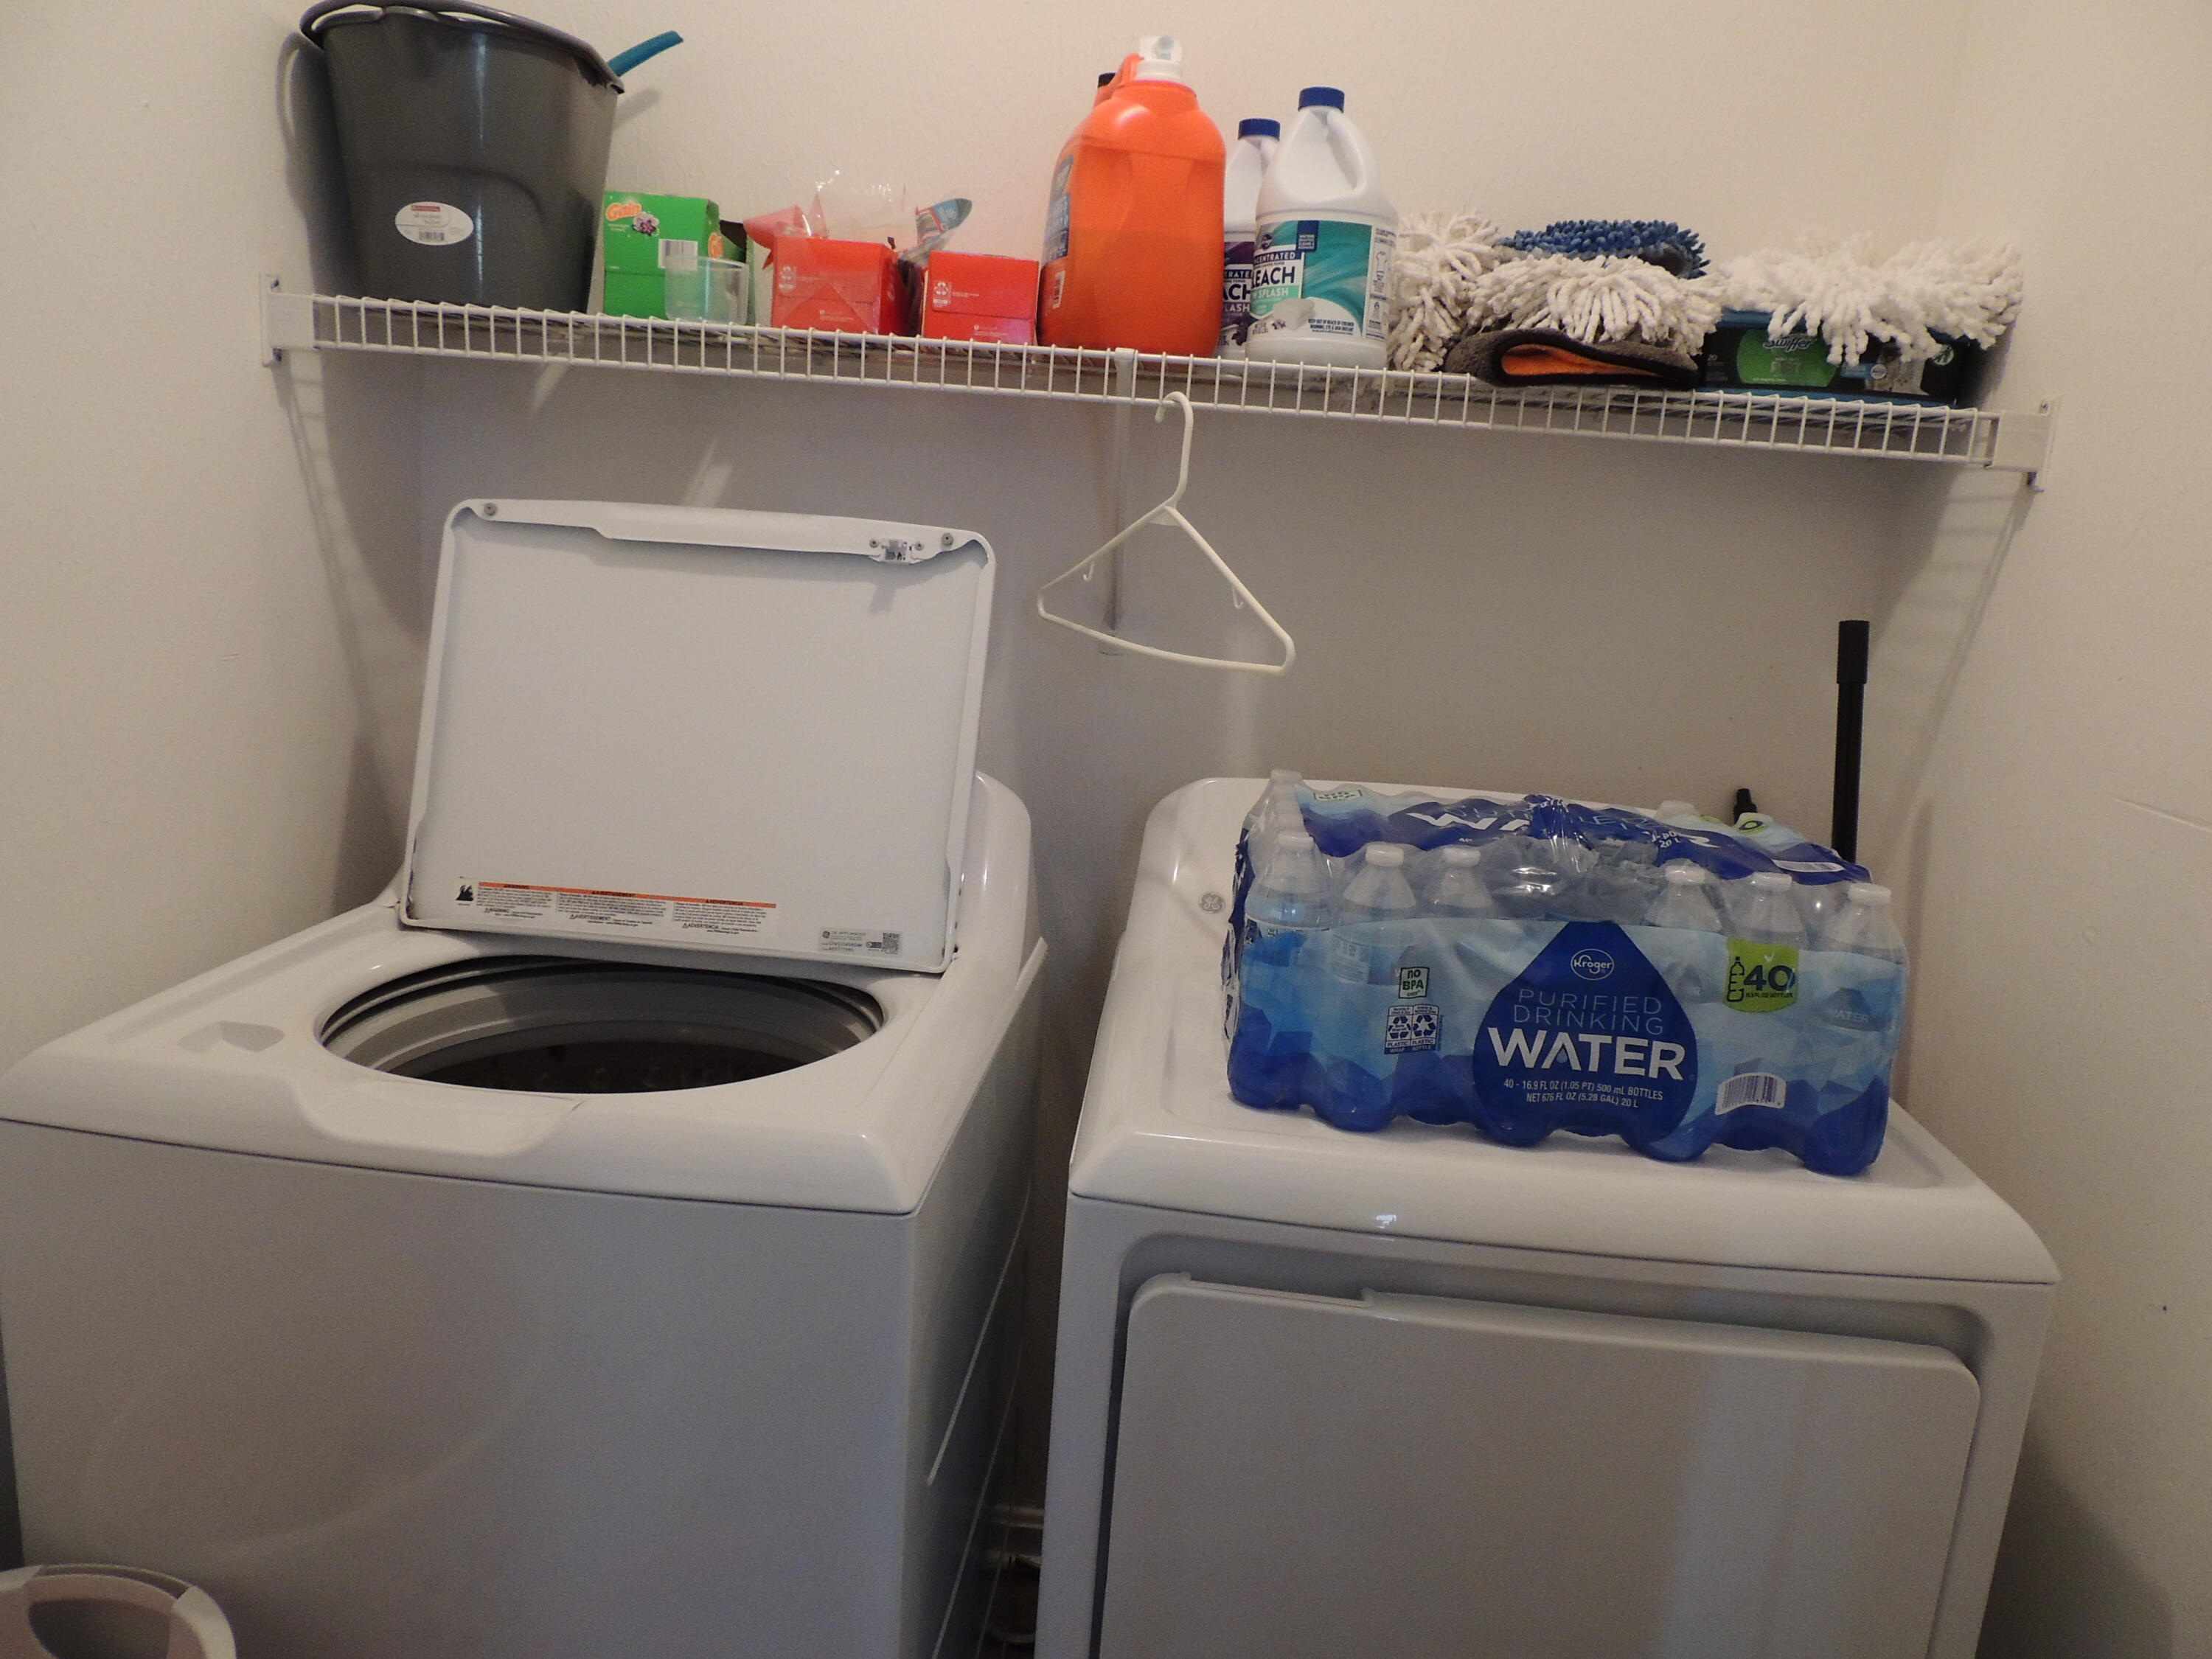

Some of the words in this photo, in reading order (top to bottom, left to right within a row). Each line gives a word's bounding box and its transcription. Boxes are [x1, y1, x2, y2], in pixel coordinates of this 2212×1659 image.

[1573, 955, 1612, 974] Kroger
[1402, 980, 1424, 990] BPA
[1743, 965, 1795, 991] 40
[1519, 989, 1661, 1015] PURIFIED
[1514, 1004, 1663, 1035] DRINKING
[1487, 1027, 1686, 1081] WATER
[1504, 1079, 1514, 1088] 40
[1523, 1080, 1538, 1090] 16.9
[1540, 1081, 1548, 1090] FL
[1550, 1081, 1559, 1090] OZ
[1561, 1080, 1579, 1091] (1.05
[1582, 1082, 1595, 1092] PT)
[1596, 1083, 1612, 1093] 500
[1613, 1085, 1625, 1095] mL
[1628, 1087, 1663, 1100] BOTTLES
[1527, 1093, 1541, 1103] NET
[1542, 1093, 1554, 1102] 676
[1555, 1092, 1564, 1101] FL
[1566, 1092, 1576, 1100] OZ
[1578, 1093, 1598, 1103] (5.28
[1600, 1093, 1620, 1105] GAL)
[1621, 1098, 1632, 1107] 20
[1633, 1099, 1638, 1107] L
